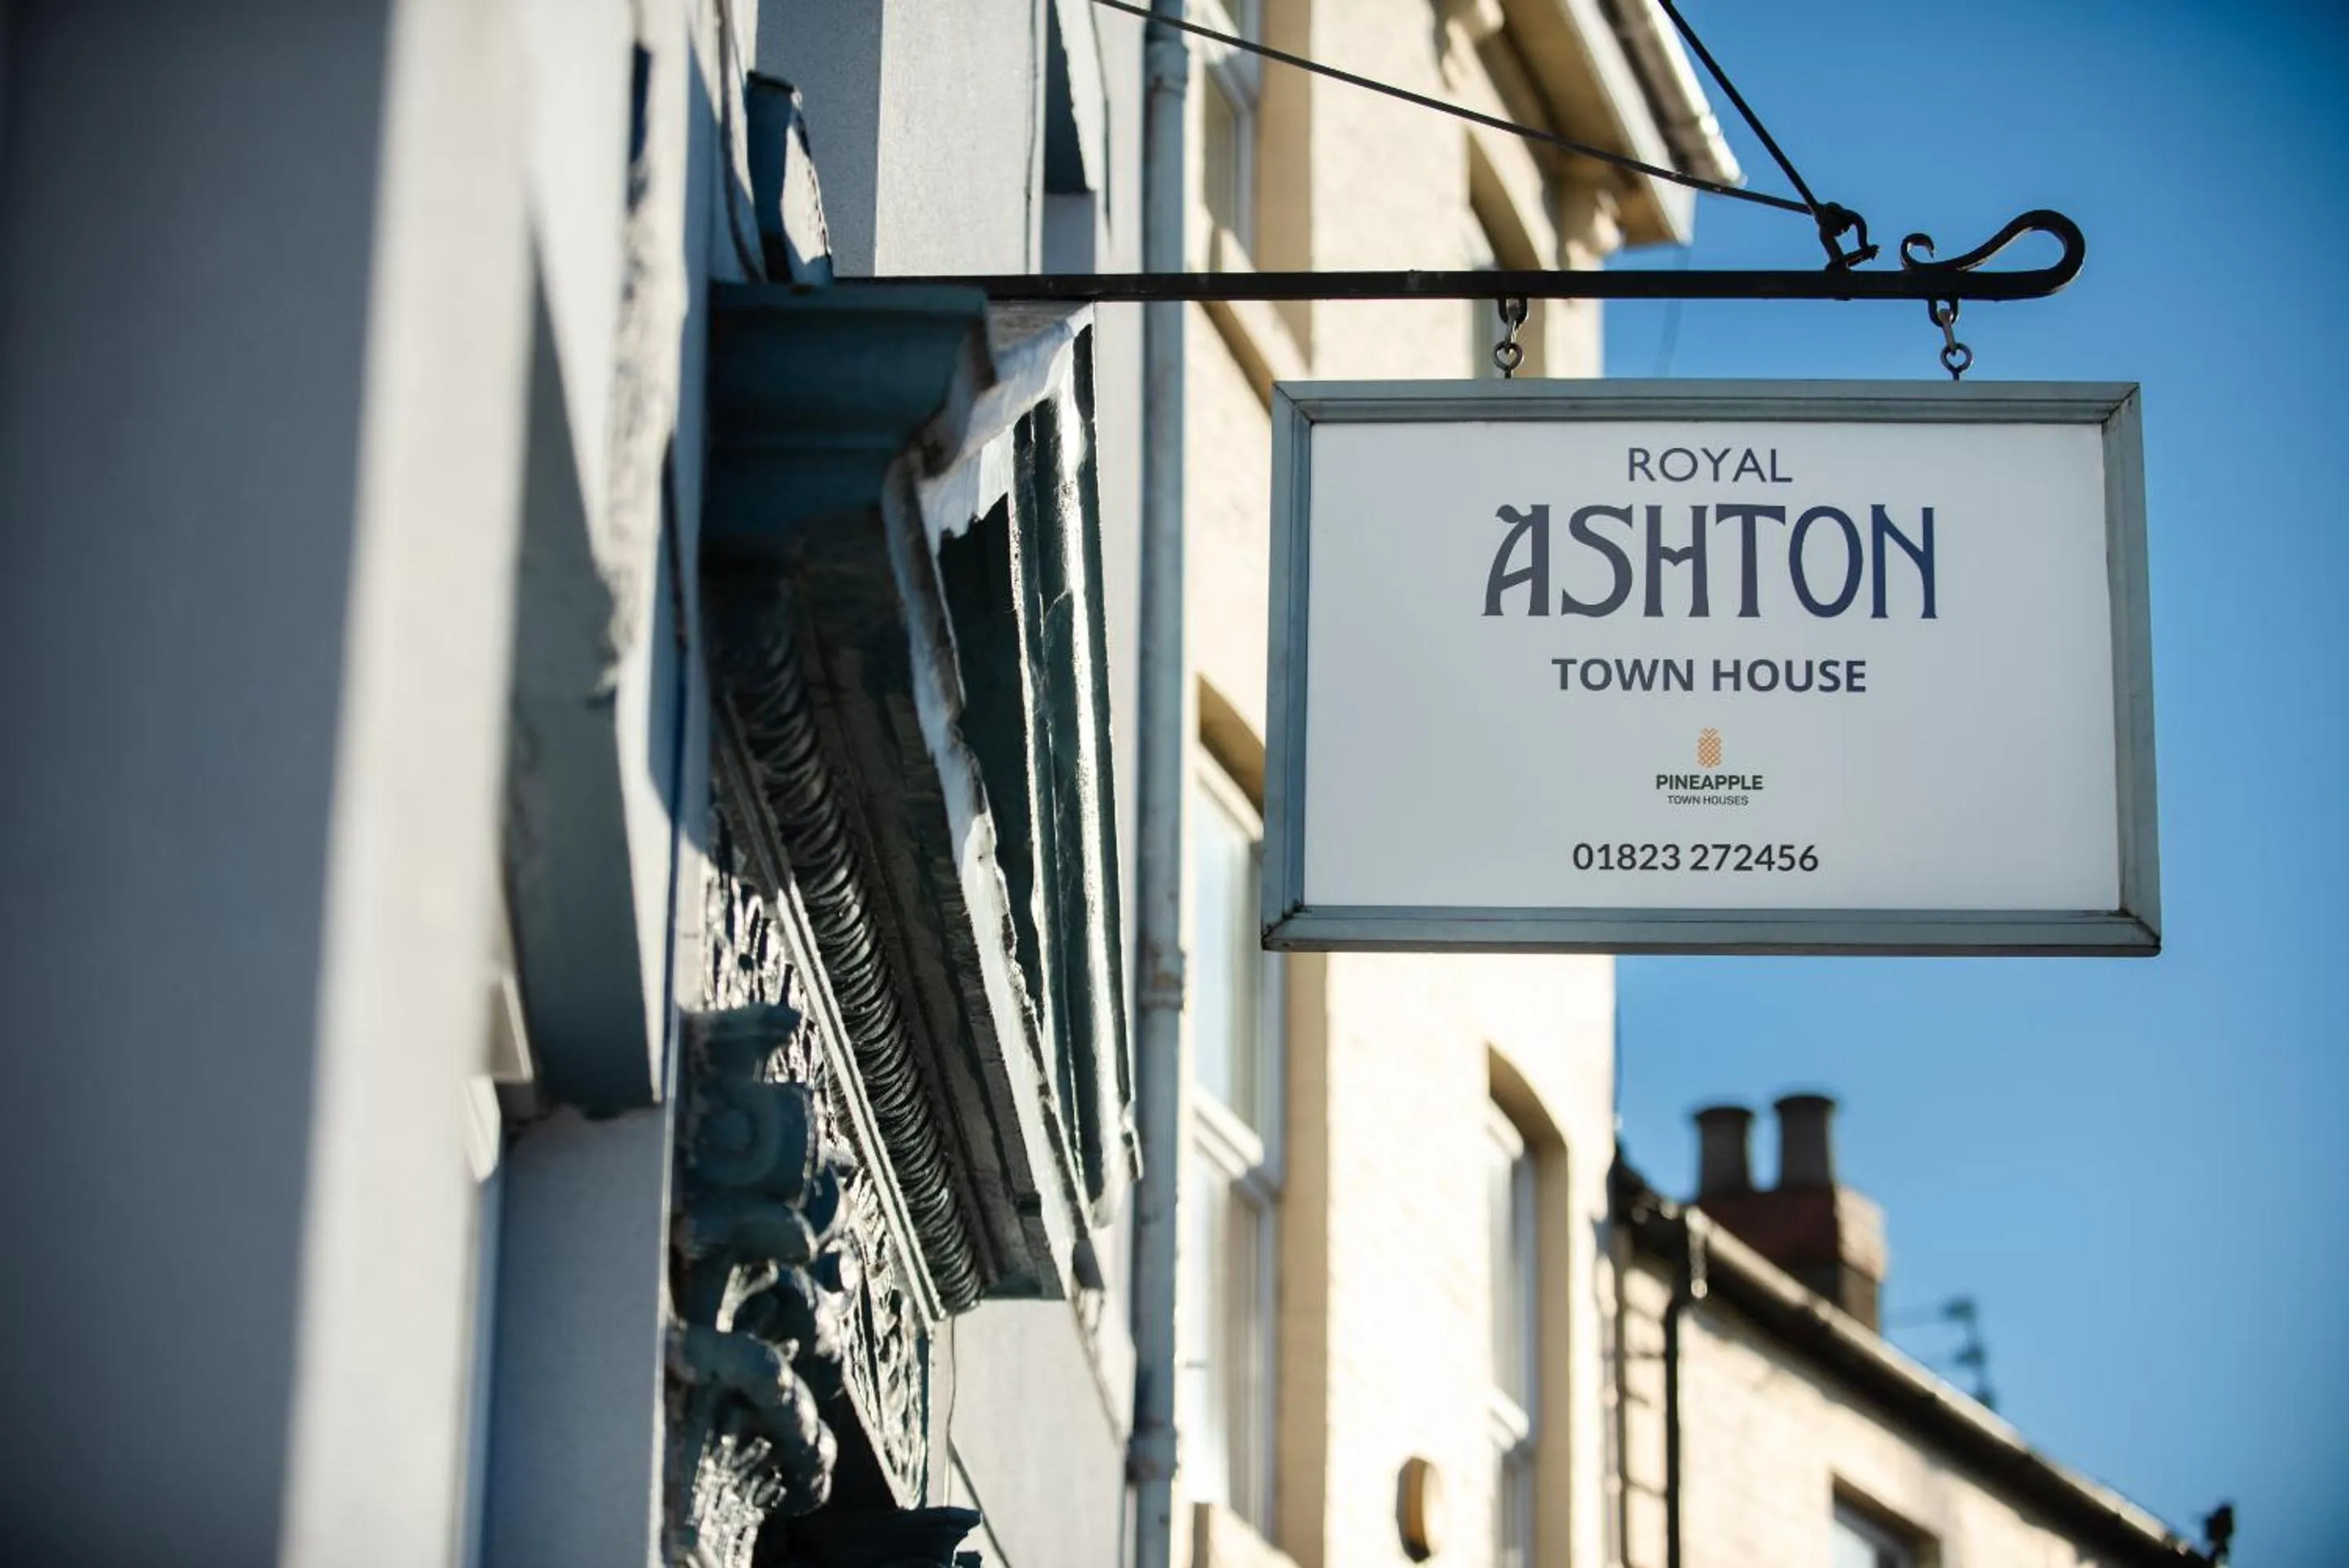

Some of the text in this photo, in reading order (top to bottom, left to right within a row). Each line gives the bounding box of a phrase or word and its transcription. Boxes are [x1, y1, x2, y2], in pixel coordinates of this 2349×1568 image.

[1628, 447, 1794, 484] ROYAL
[1481, 502, 1938, 621] ASHTON
[1551, 659, 1867, 693] TOWN HOUSE
[1655, 774, 1764, 791] PINEAPPLE
[1667, 795, 1750, 806] TOWN HOUSES
[1572, 842, 1819, 872] 01823 272456
